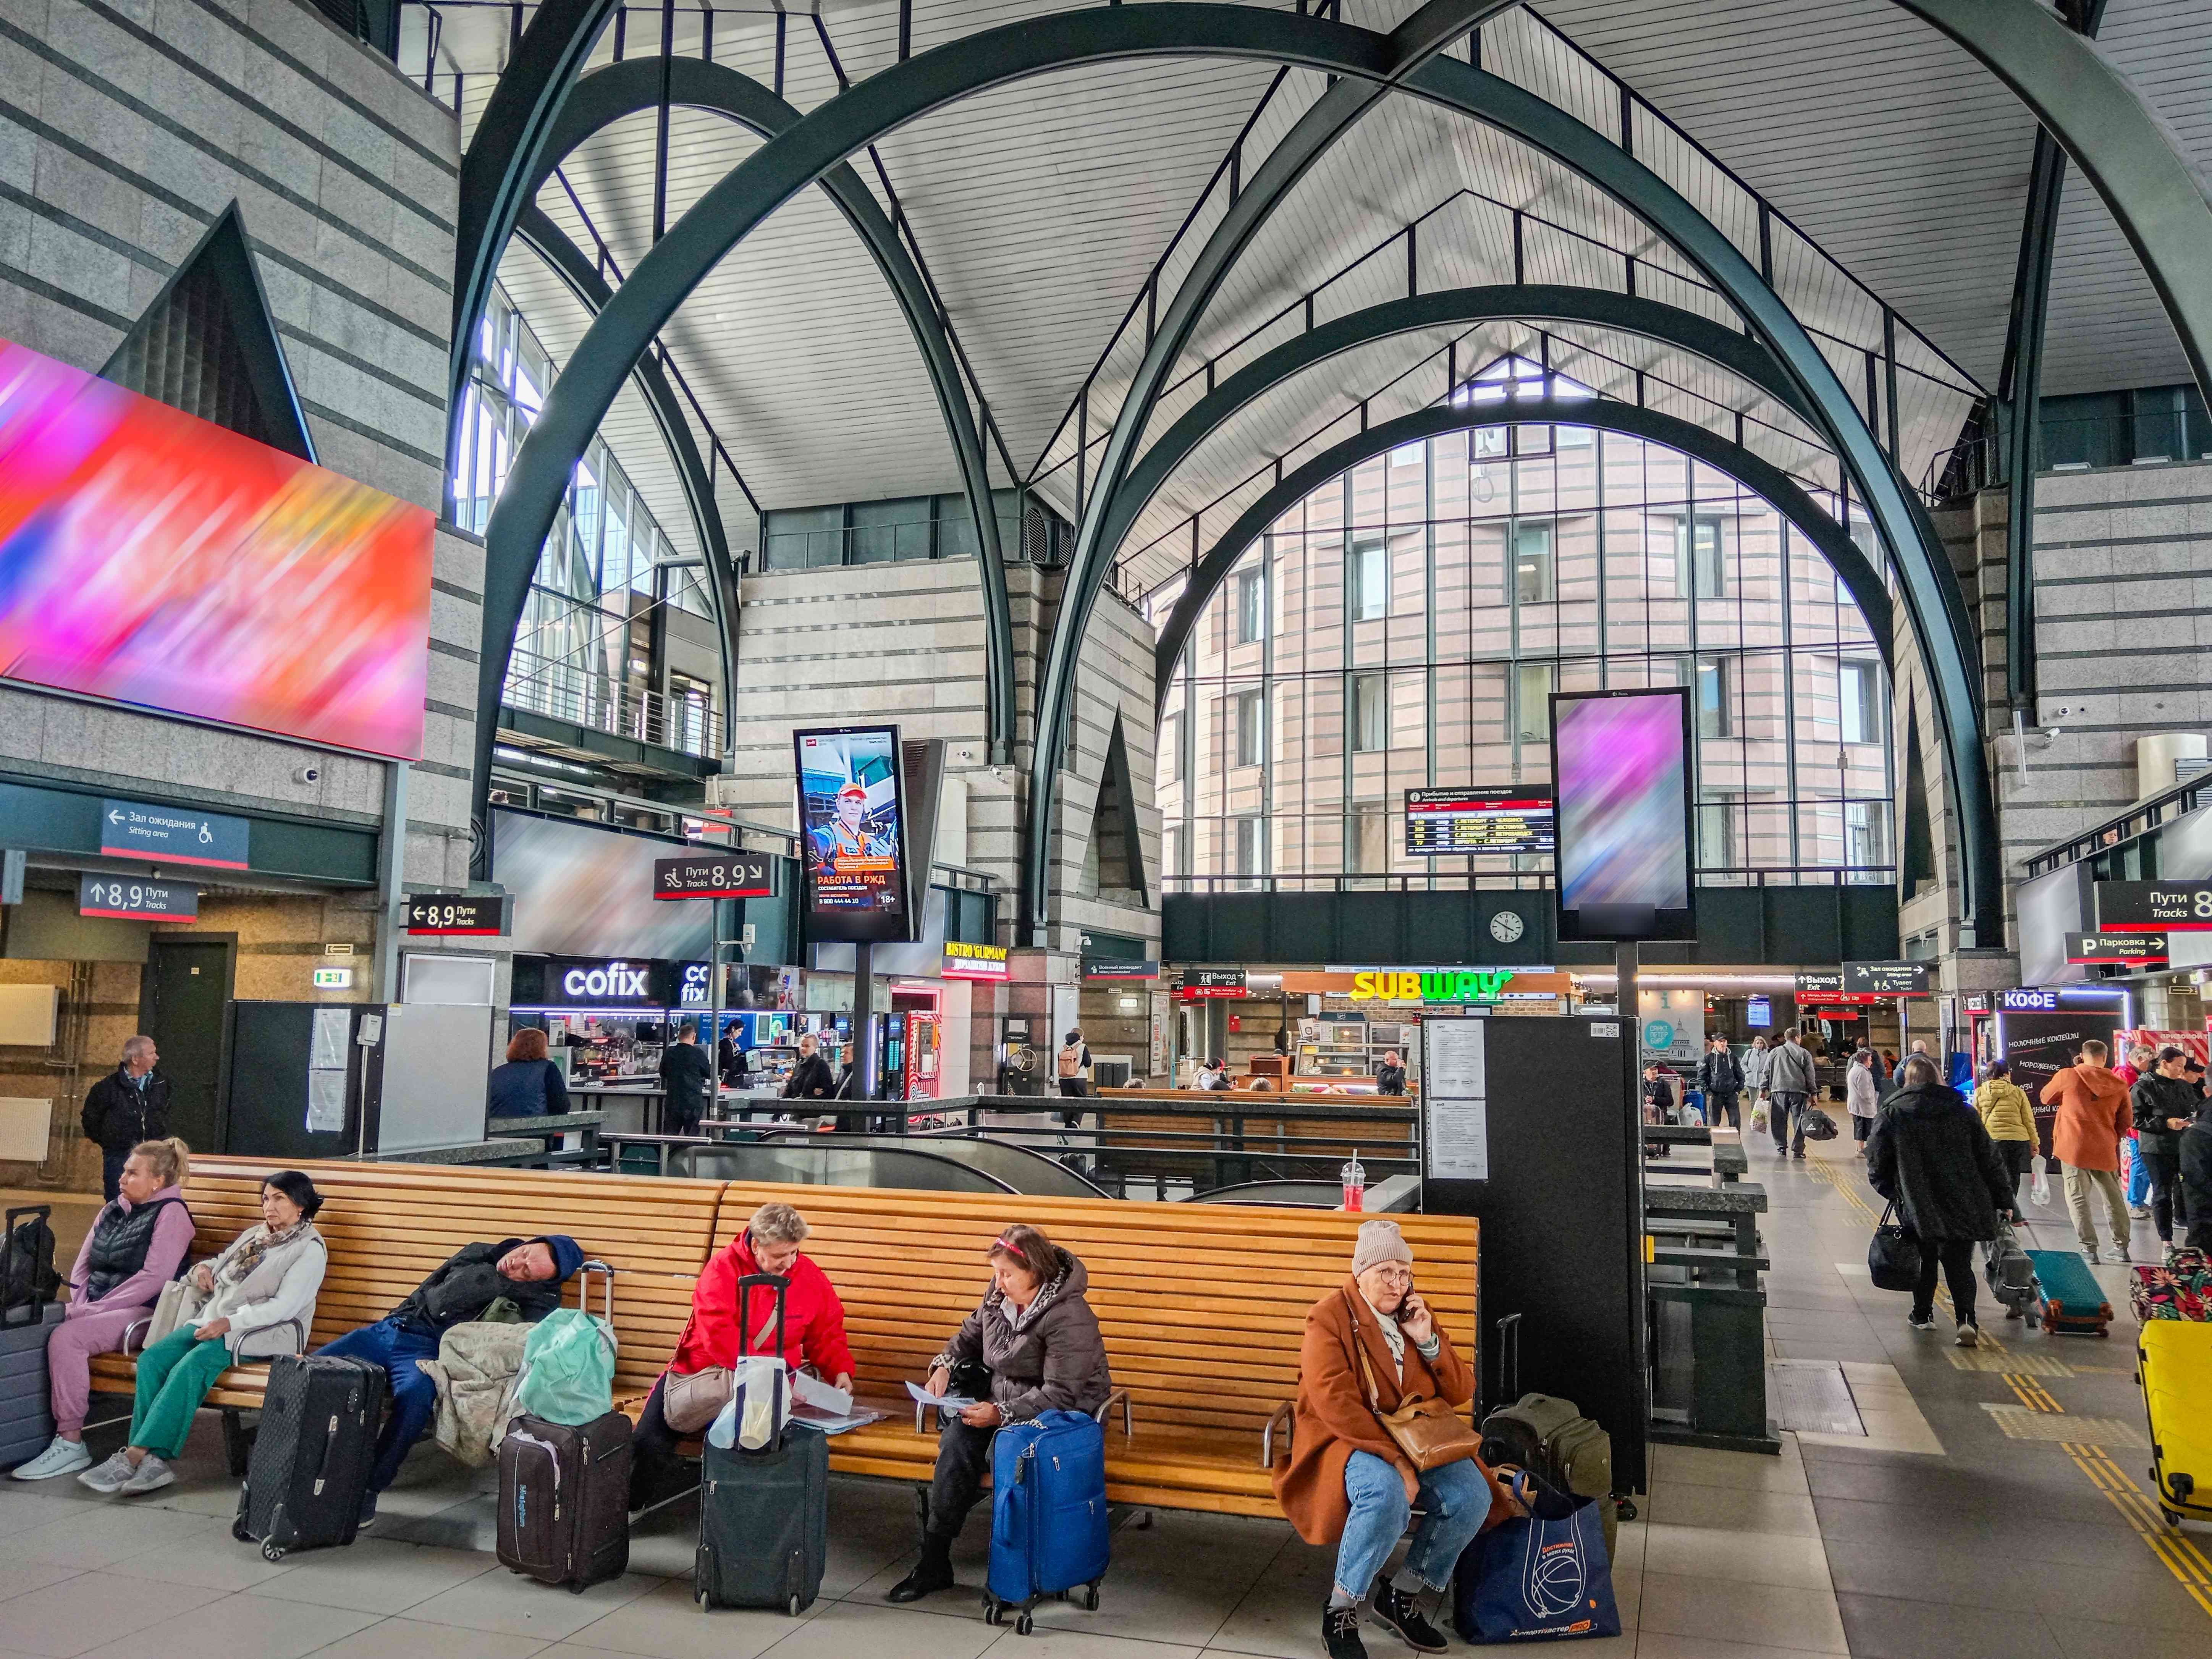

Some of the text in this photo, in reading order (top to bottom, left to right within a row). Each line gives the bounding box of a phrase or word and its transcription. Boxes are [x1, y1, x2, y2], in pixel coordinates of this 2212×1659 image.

[129, 812, 196, 829] Зал ожидания
[128, 826, 151, 837] Sitting
[686, 865, 745, 889] Пути 8,9
[686, 879, 708, 887] Tracks
[817, 876, 852, 884] РАБОТА
[864, 875, 886, 884] РЖД
[108, 884, 168, 910] 8,9 Пути
[881, 895, 896, 903] 18+
[2150, 892, 2187, 906] Пути
[146, 901, 167, 909] Tracks
[427, 906, 476, 928] 8,9 Пути
[2152, 909, 2188, 918] Tracks
[946, 942, 972, 958] BISTRO
[2083, 939, 2146, 955] P Парковка
[564, 962, 648, 996] cofix
[1212, 973, 1237, 981] Выход
[1807, 976, 1837, 985] Выход
[682, 983, 704, 1001] fix
[1350, 970, 1514, 1001] SUBWAY
[2005, 993, 2055, 1008] КОФЕ
[2008, 1032, 2079, 1048] МОЛОЧНЫЕ КОКТЕЙЛИ
[2019, 1060, 2060, 1071] МОРОЖЕНОЕ
